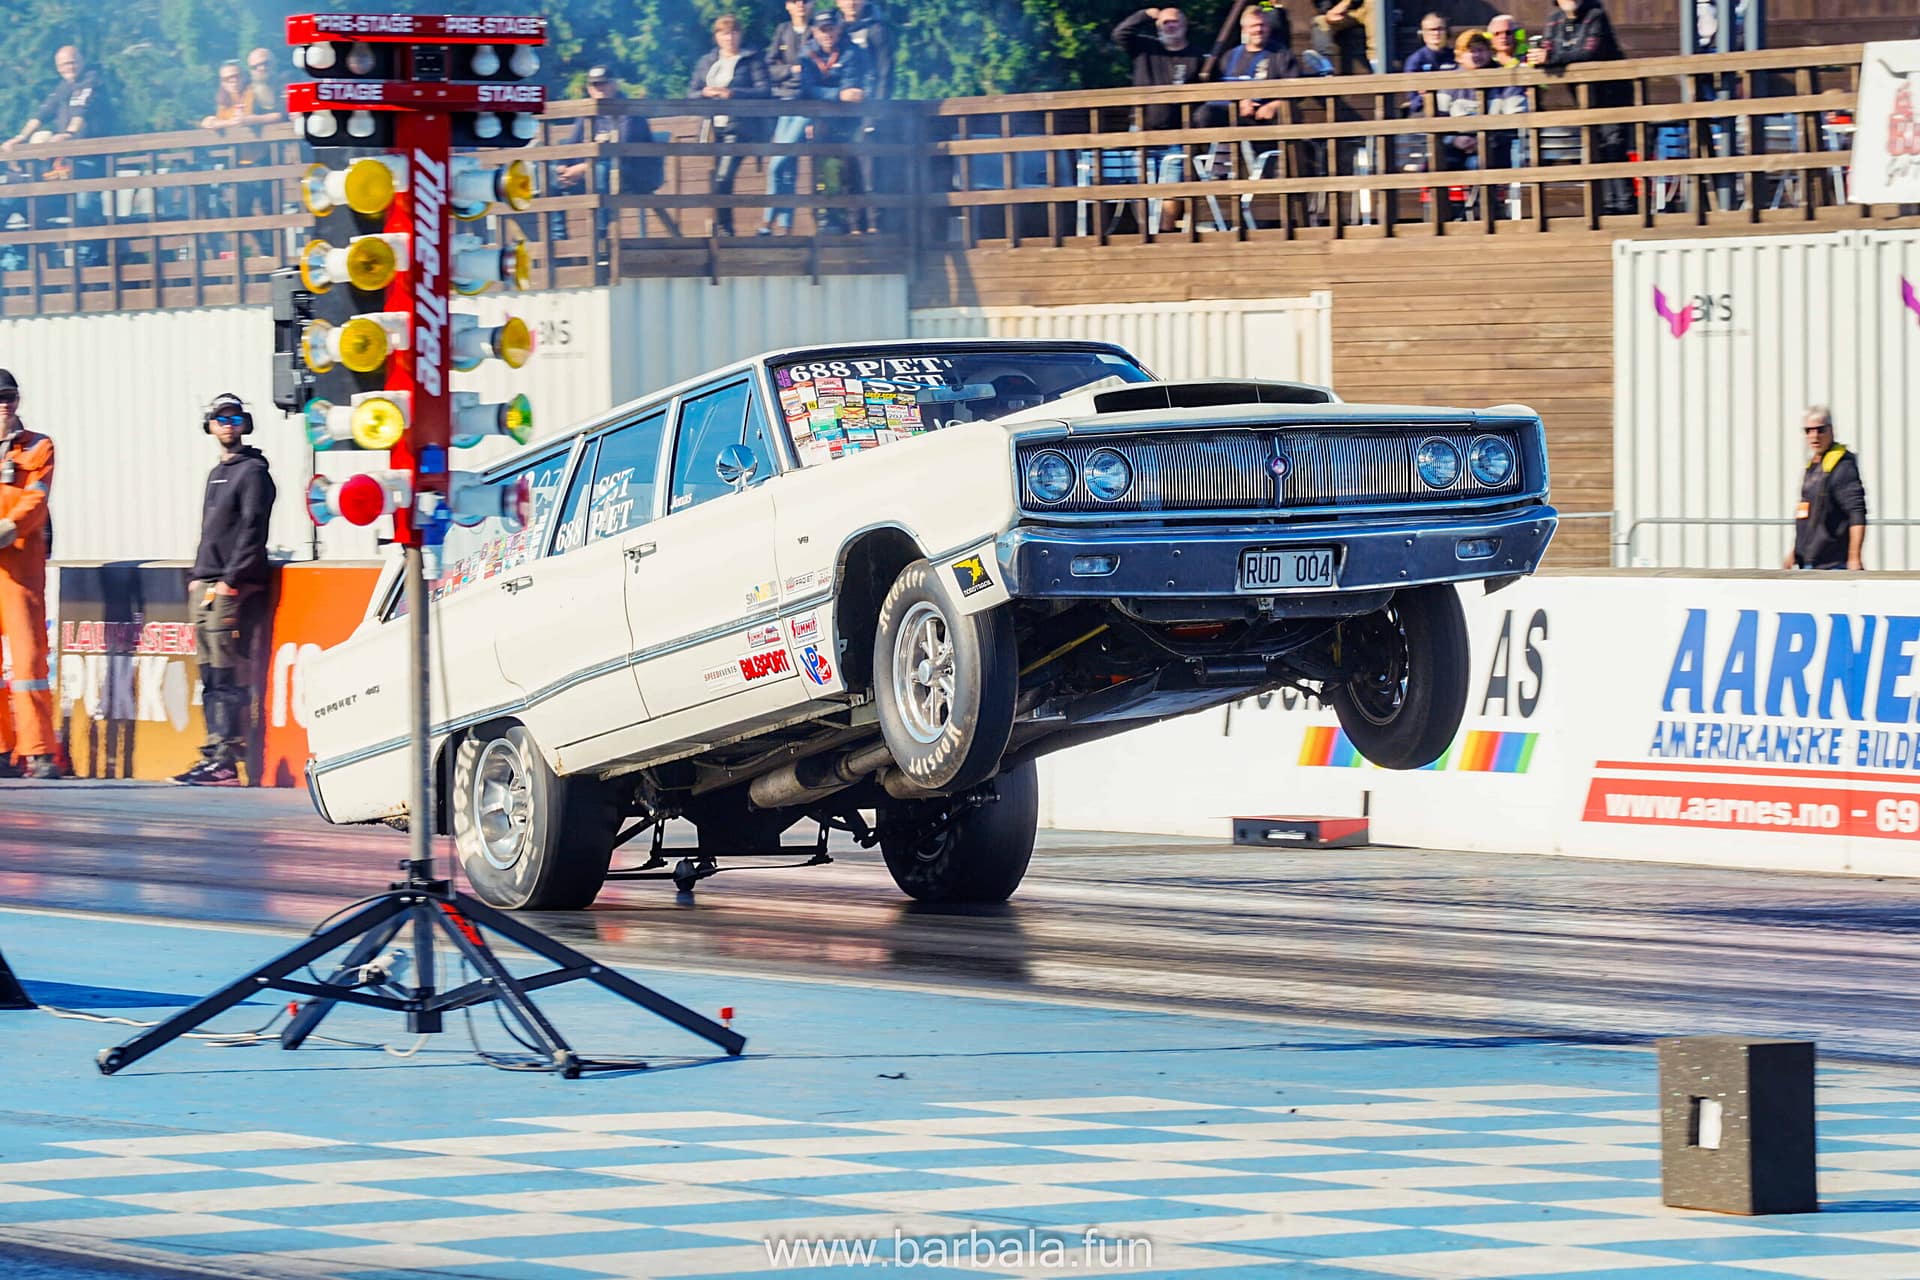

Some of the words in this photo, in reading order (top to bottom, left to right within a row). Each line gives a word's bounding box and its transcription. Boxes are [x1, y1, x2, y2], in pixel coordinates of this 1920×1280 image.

[317, 16, 413, 32] PRE-STAGE
[445, 17, 539, 34] PRE-STAGE
[317, 84, 384, 100] STAGE
[477, 86, 542, 102] STAGE
[414, 148, 448, 397] Time-Tree
[789, 361, 851, 382] 688
[851, 357, 945, 378] P/ET
[1246, 556, 1280, 585] RUD
[1296, 554, 1330, 582] 004
[739, 649, 791, 681] BILSPORT
[1661, 608, 1920, 724] AARNE
[1648, 720, 1842, 766] AMERIKANSKE
[1605, 793, 1840, 828] www.aarnes.no
[1875, 799, 1920, 834] 69
